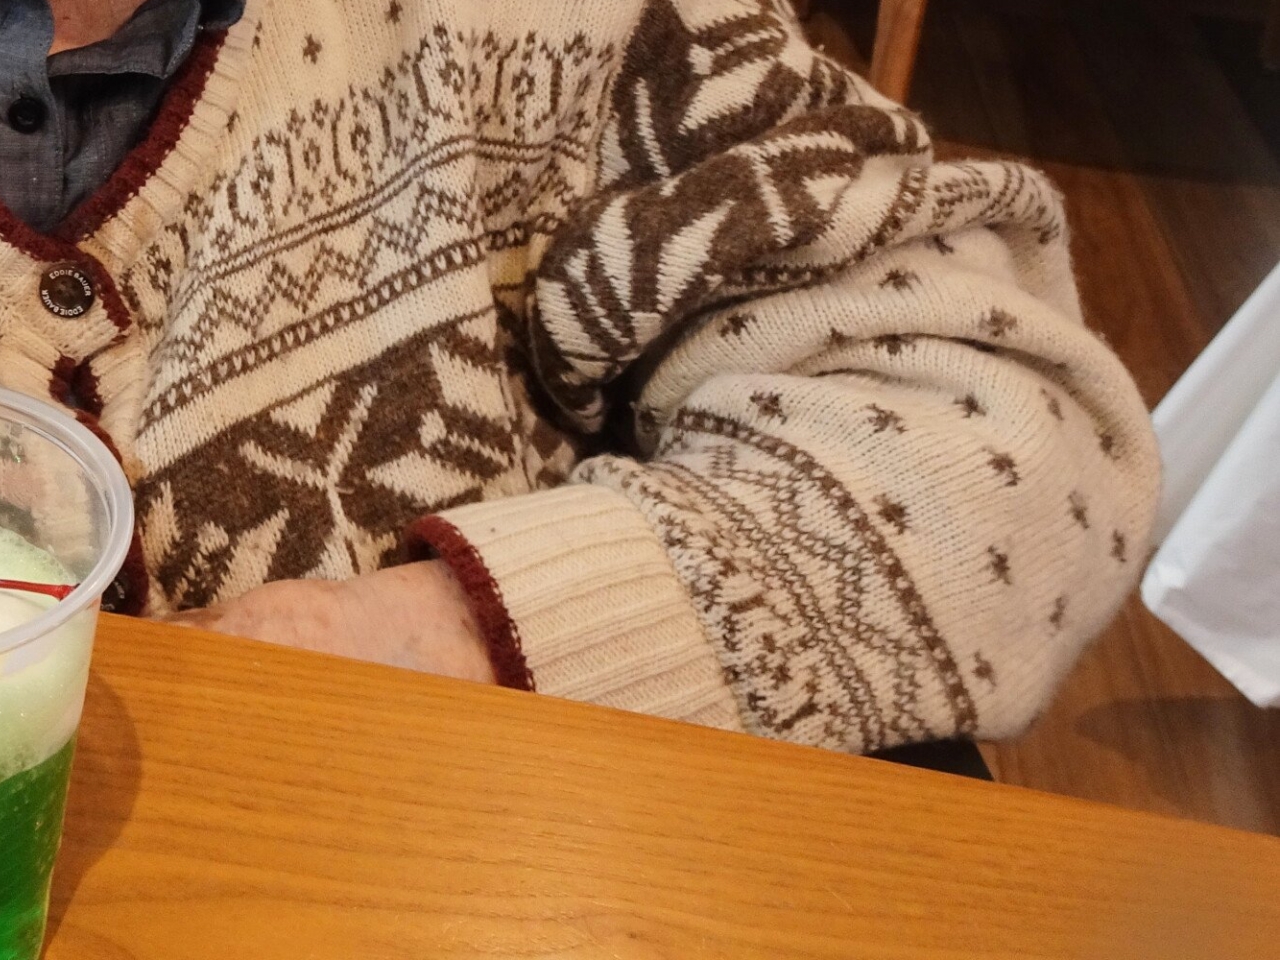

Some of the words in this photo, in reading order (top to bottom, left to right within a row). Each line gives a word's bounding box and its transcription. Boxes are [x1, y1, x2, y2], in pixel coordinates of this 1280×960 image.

[49, 269, 73, 280] EDDIE
[73, 272, 92, 296] BAUER
[41, 289, 59, 313] BAUER
[60, 305, 84, 316] EDDIE
